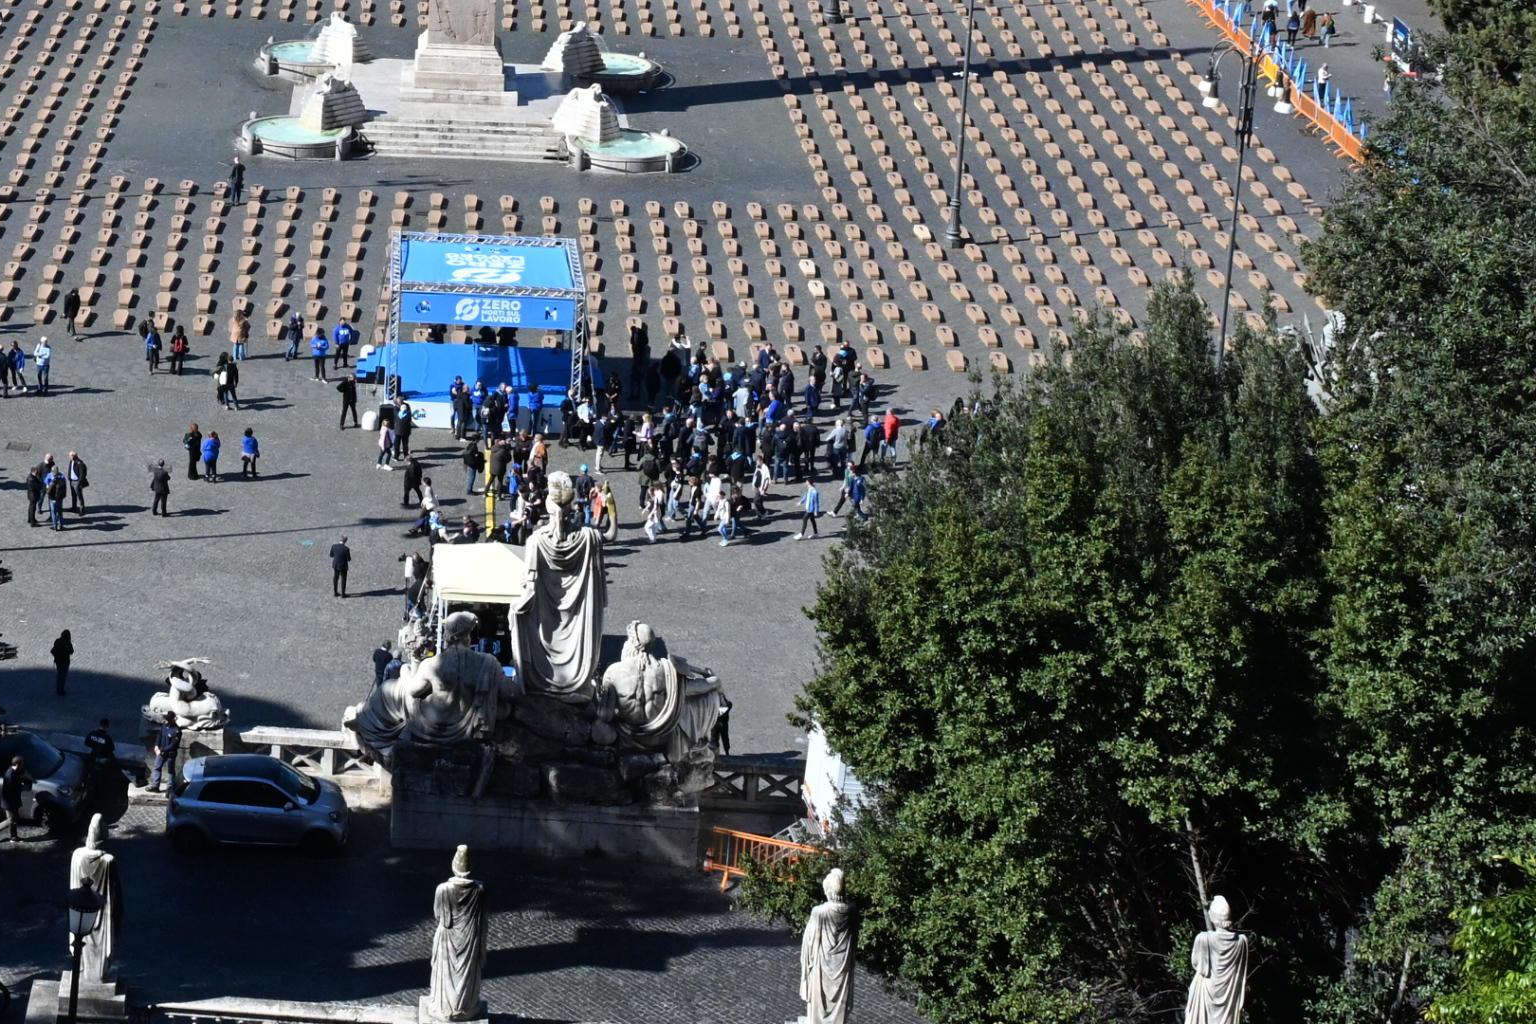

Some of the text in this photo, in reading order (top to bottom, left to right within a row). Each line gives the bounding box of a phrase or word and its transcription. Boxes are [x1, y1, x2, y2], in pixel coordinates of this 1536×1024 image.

[482, 299, 521, 311] ZERO
[481, 309, 505, 317] MORTI
[481, 315, 521, 324] LAVORO
